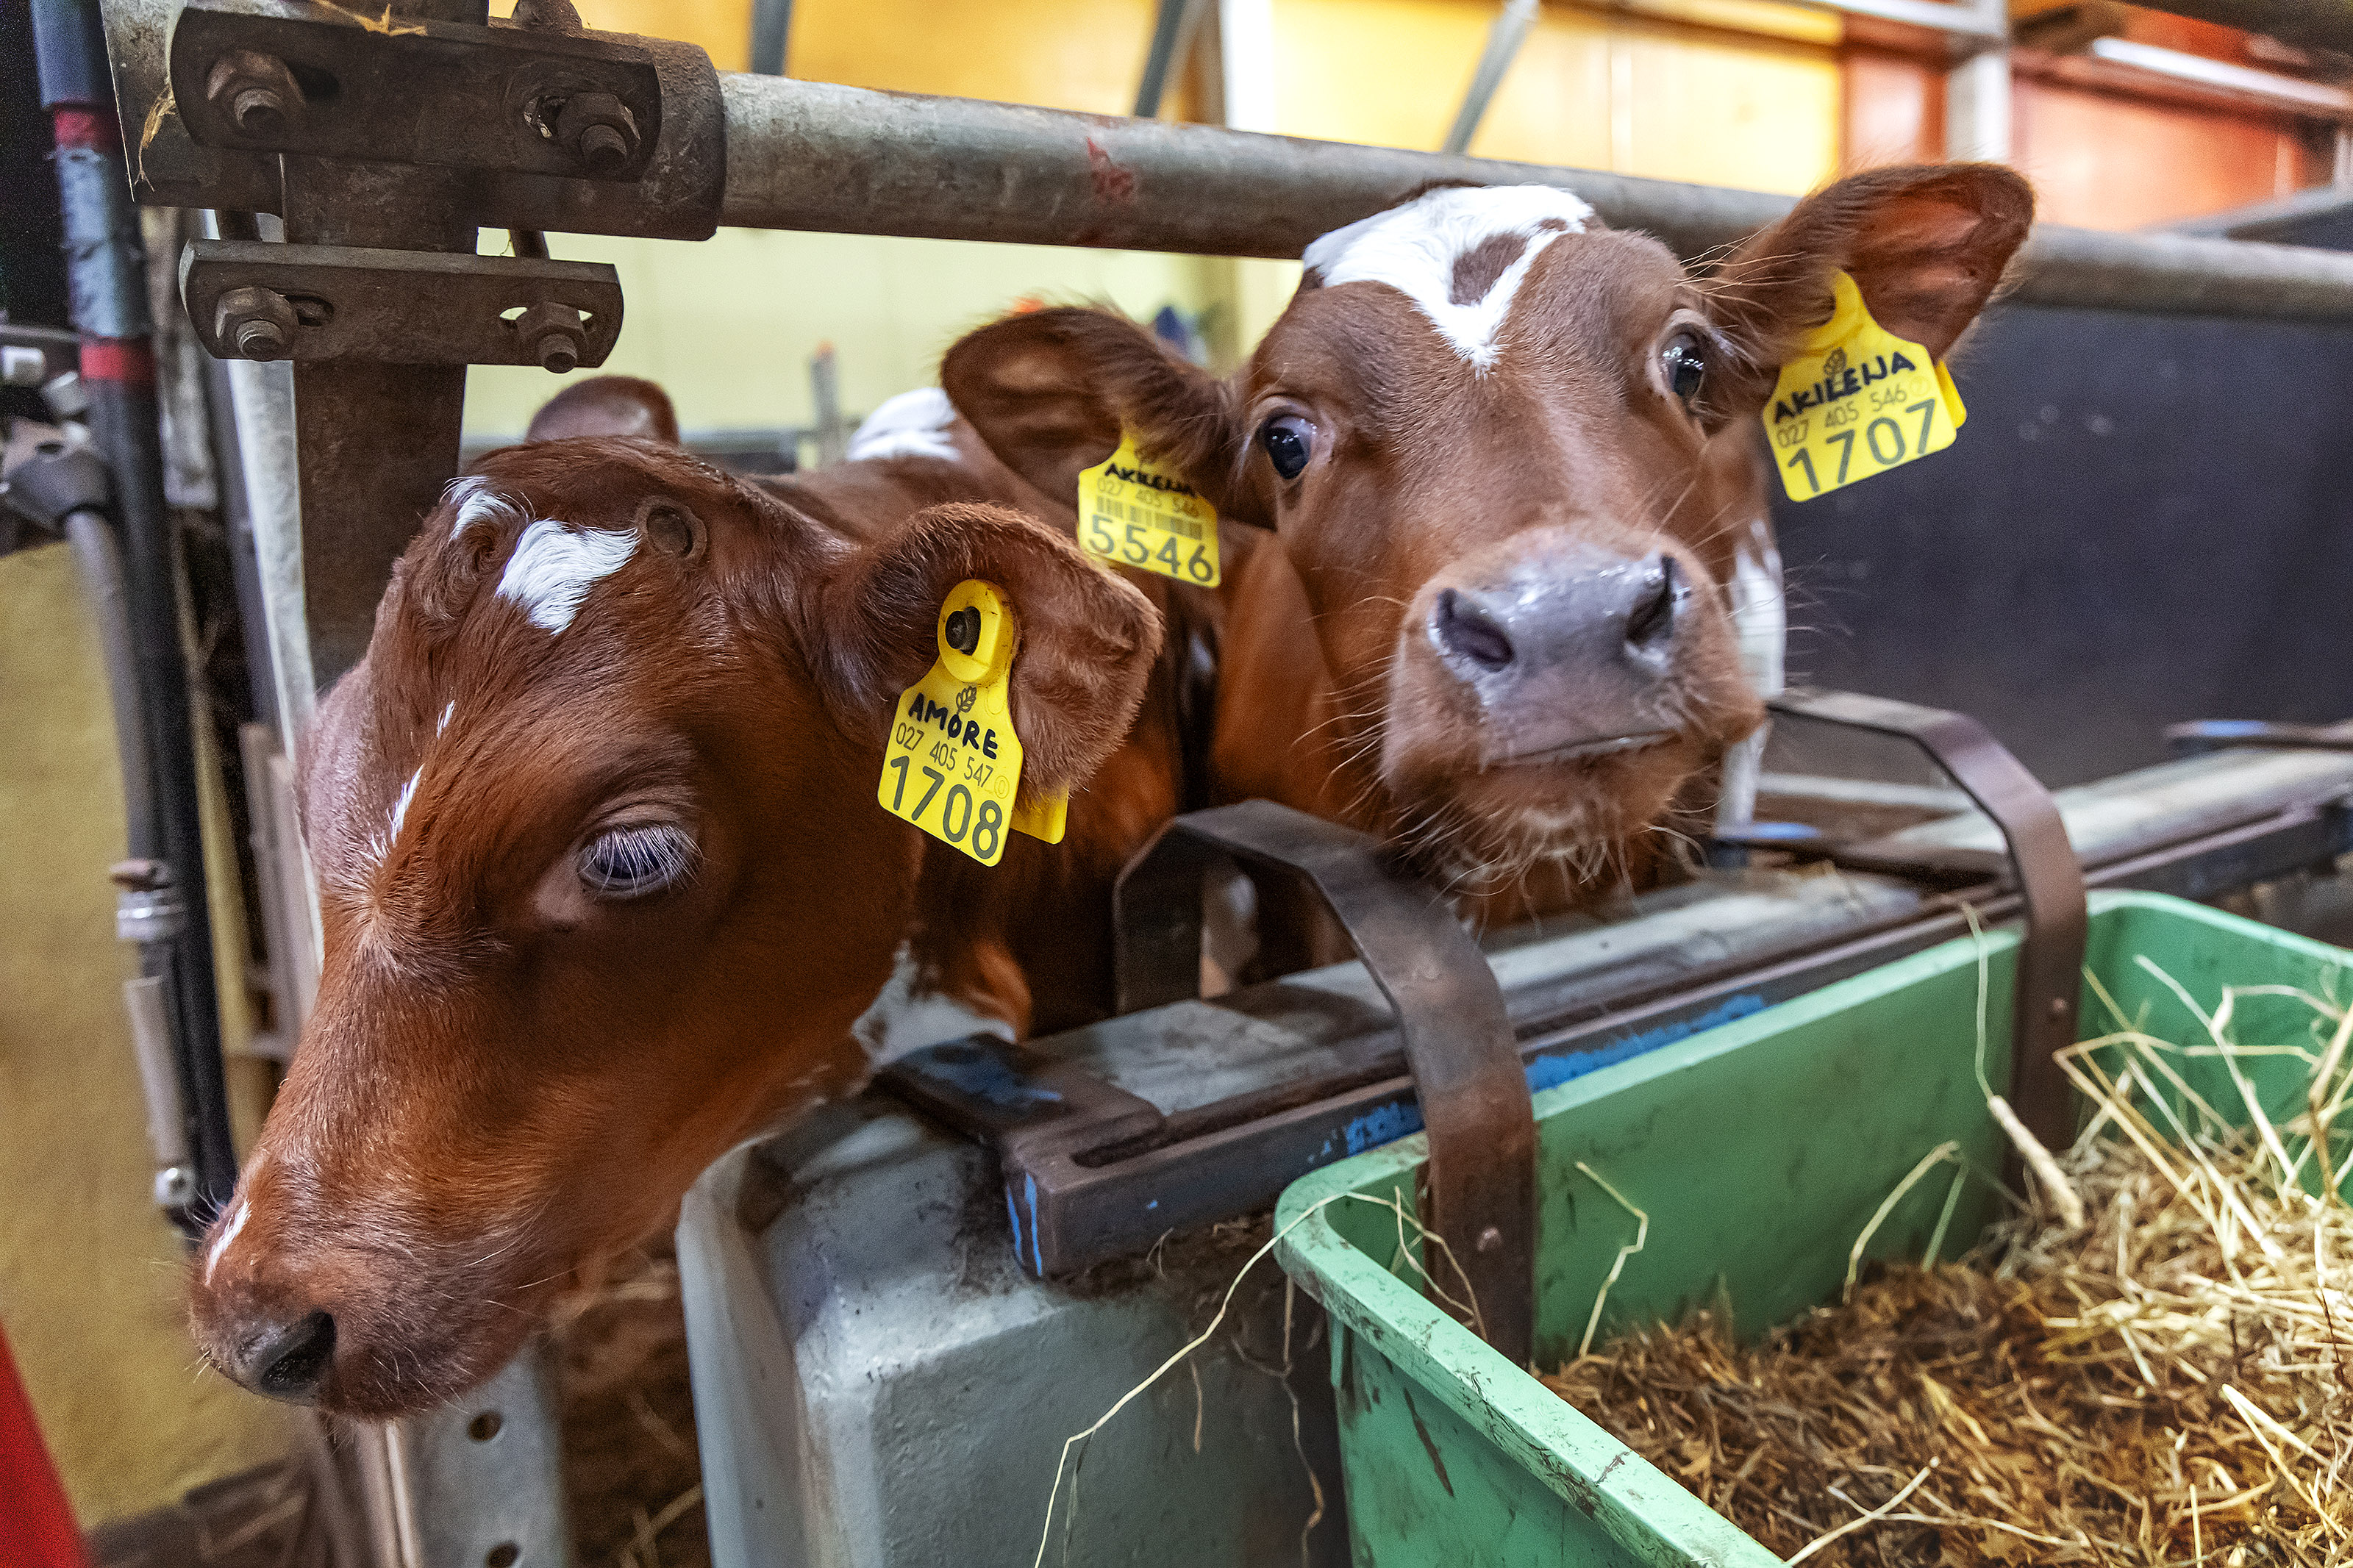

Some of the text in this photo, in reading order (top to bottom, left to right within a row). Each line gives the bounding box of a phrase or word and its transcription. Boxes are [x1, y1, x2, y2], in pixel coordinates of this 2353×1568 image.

[1775, 418, 1810, 449] 027
[1824, 401, 1860, 429] 405
[1868, 383, 1907, 413] 546
[1787, 398, 1935, 493] 1707
[1096, 476, 1124, 497] 027
[1089, 513, 1214, 583] 5546
[895, 721, 926, 752] 027
[929, 740, 956, 772] 405
[963, 756, 995, 789] 547
[908, 692, 999, 760] AMORE
[890, 755, 1003, 860] 1708
